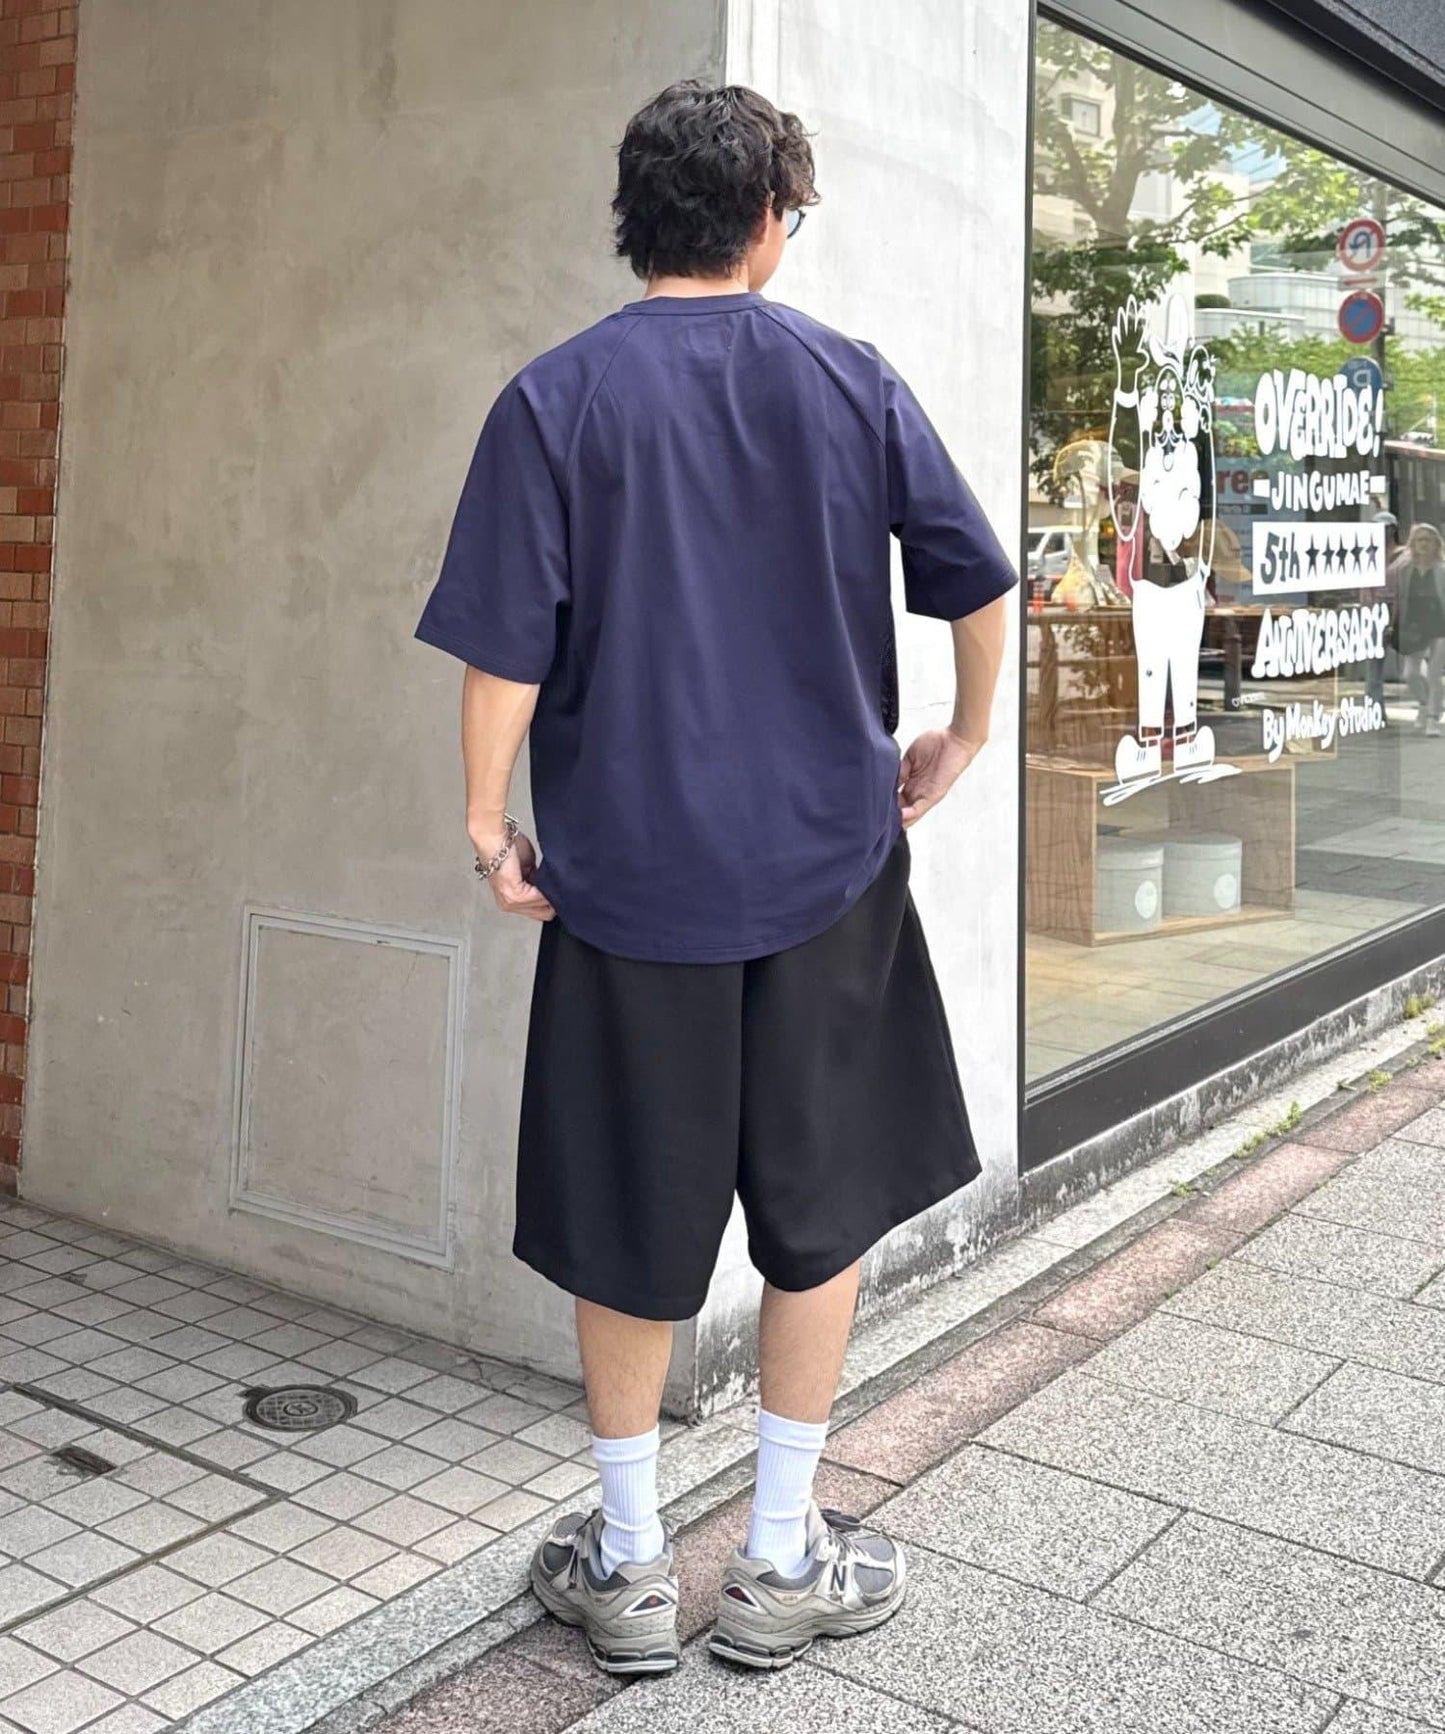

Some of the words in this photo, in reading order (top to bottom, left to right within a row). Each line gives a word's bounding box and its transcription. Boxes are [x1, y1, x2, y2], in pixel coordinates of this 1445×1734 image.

[1254, 368, 1384, 461] OVERRIDE!
[1260, 531, 1301, 585] 5th
[1251, 602, 1390, 679] ANNIVERSARY
[1262, 708, 1284, 764] By
